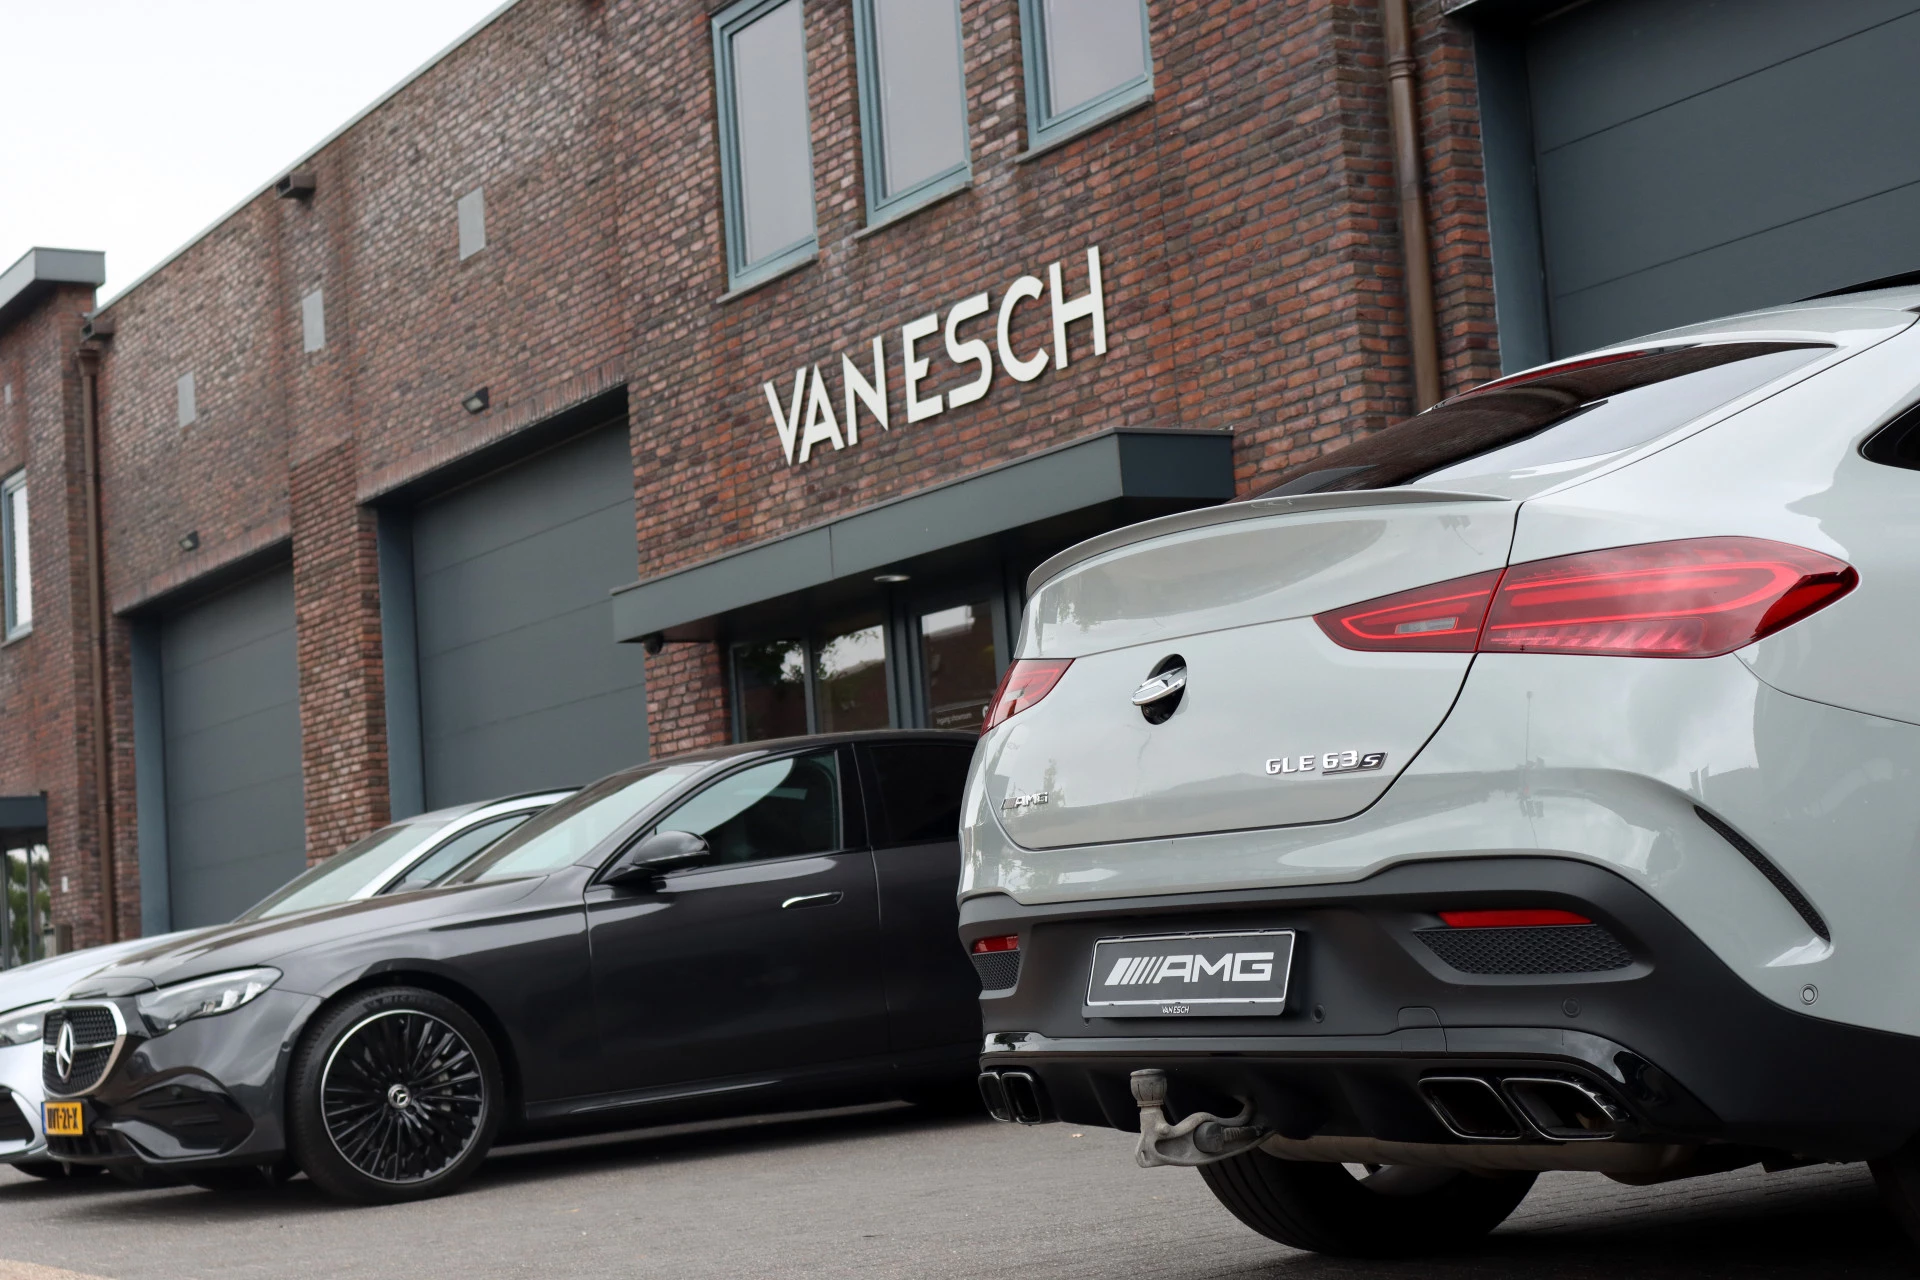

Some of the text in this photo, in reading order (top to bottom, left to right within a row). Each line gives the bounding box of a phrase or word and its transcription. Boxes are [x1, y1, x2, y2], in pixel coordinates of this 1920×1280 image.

[763, 245, 1107, 467] VAN ESCH
[1265, 755, 1316, 775] GLE
[1015, 792, 1049, 807] AMG
[1153, 952, 1275, 984] AMG
